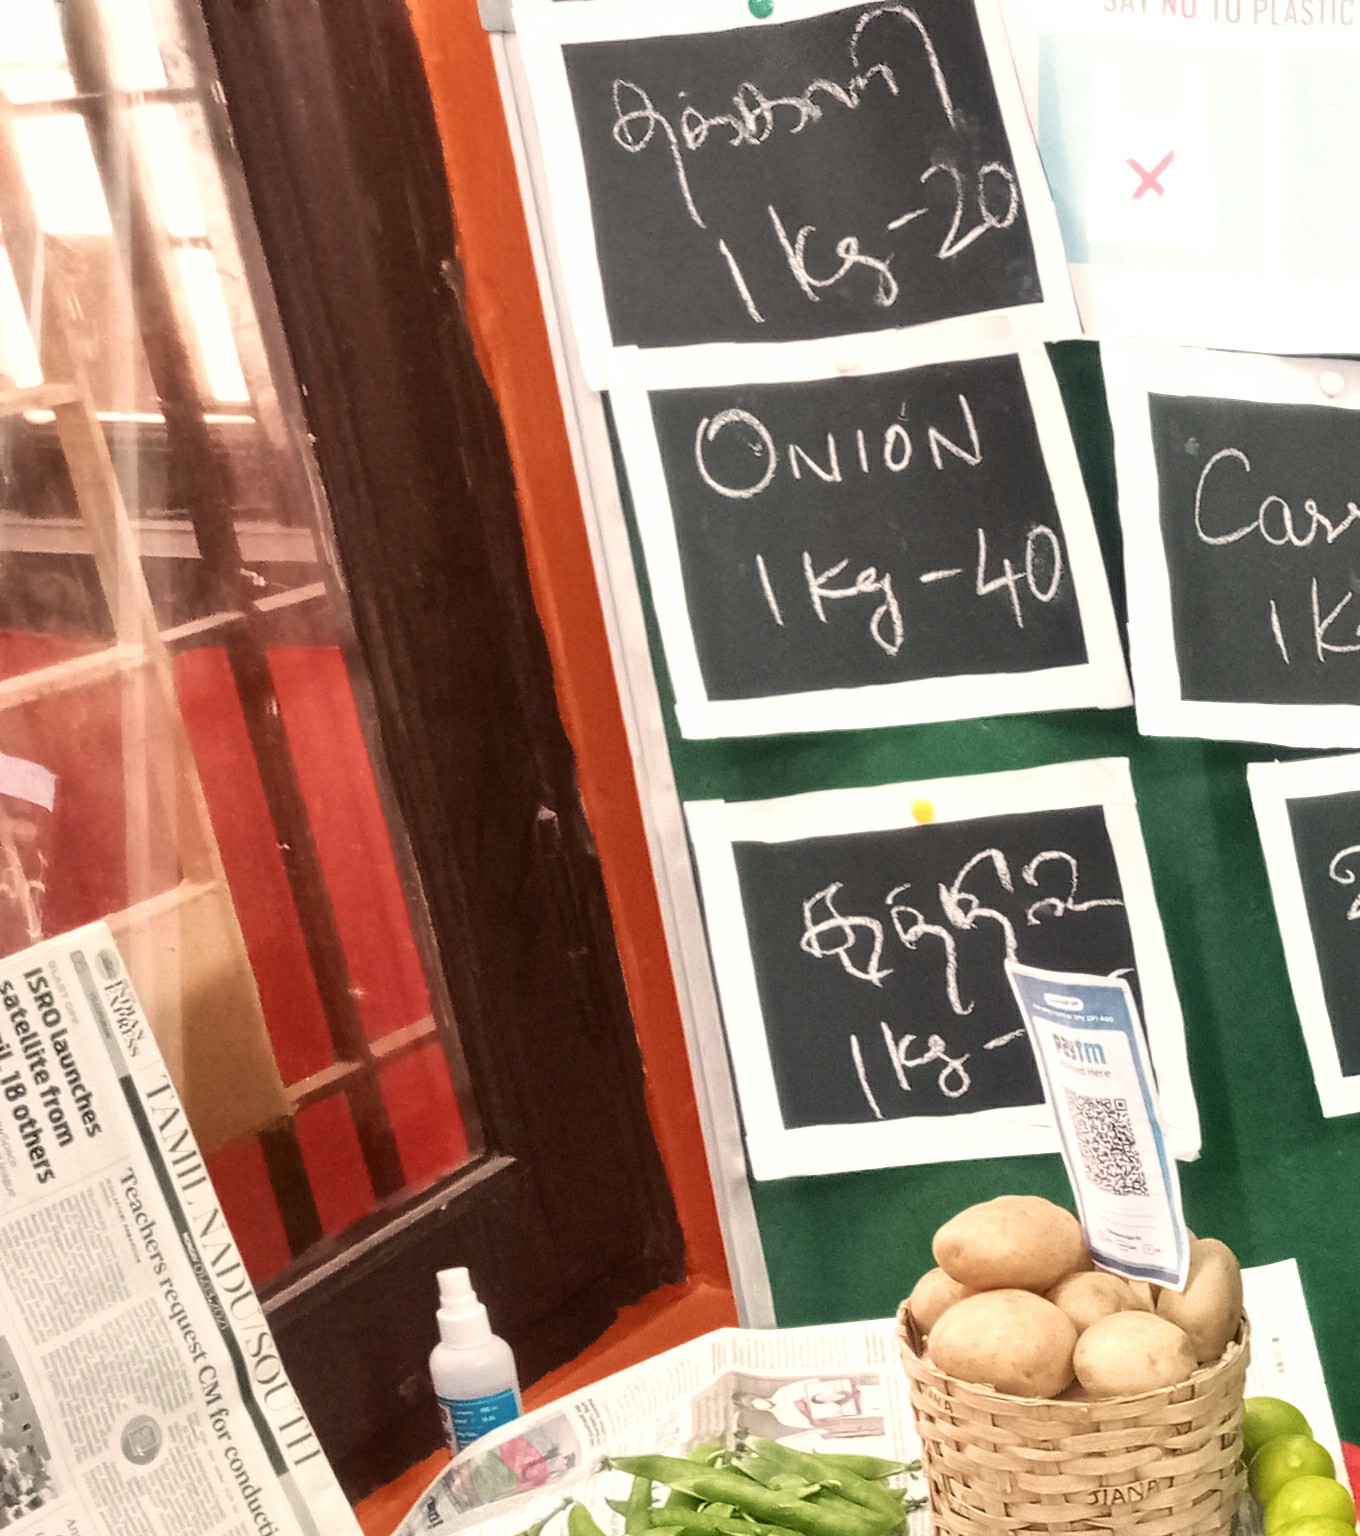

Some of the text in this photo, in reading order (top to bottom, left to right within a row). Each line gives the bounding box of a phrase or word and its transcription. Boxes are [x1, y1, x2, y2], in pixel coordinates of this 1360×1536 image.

[1210, 0, 1242, 23] TO
[1252, 0, 1354, 26] PLASTIC
[696, 394, 983, 500] ONION
[0, 978, 79, 1147] satellite from
[20, 965, 108, 1138] ISRO launches
[0, 1069, 60, 1184] 18 others
[141, 1073, 214, 1204] TAMIL
[111, 1166, 176, 1275] Teachers
[153, 1275, 209, 1365] request
[192, 1363, 227, 1406] CM
[207, 1405, 238, 1443] for
